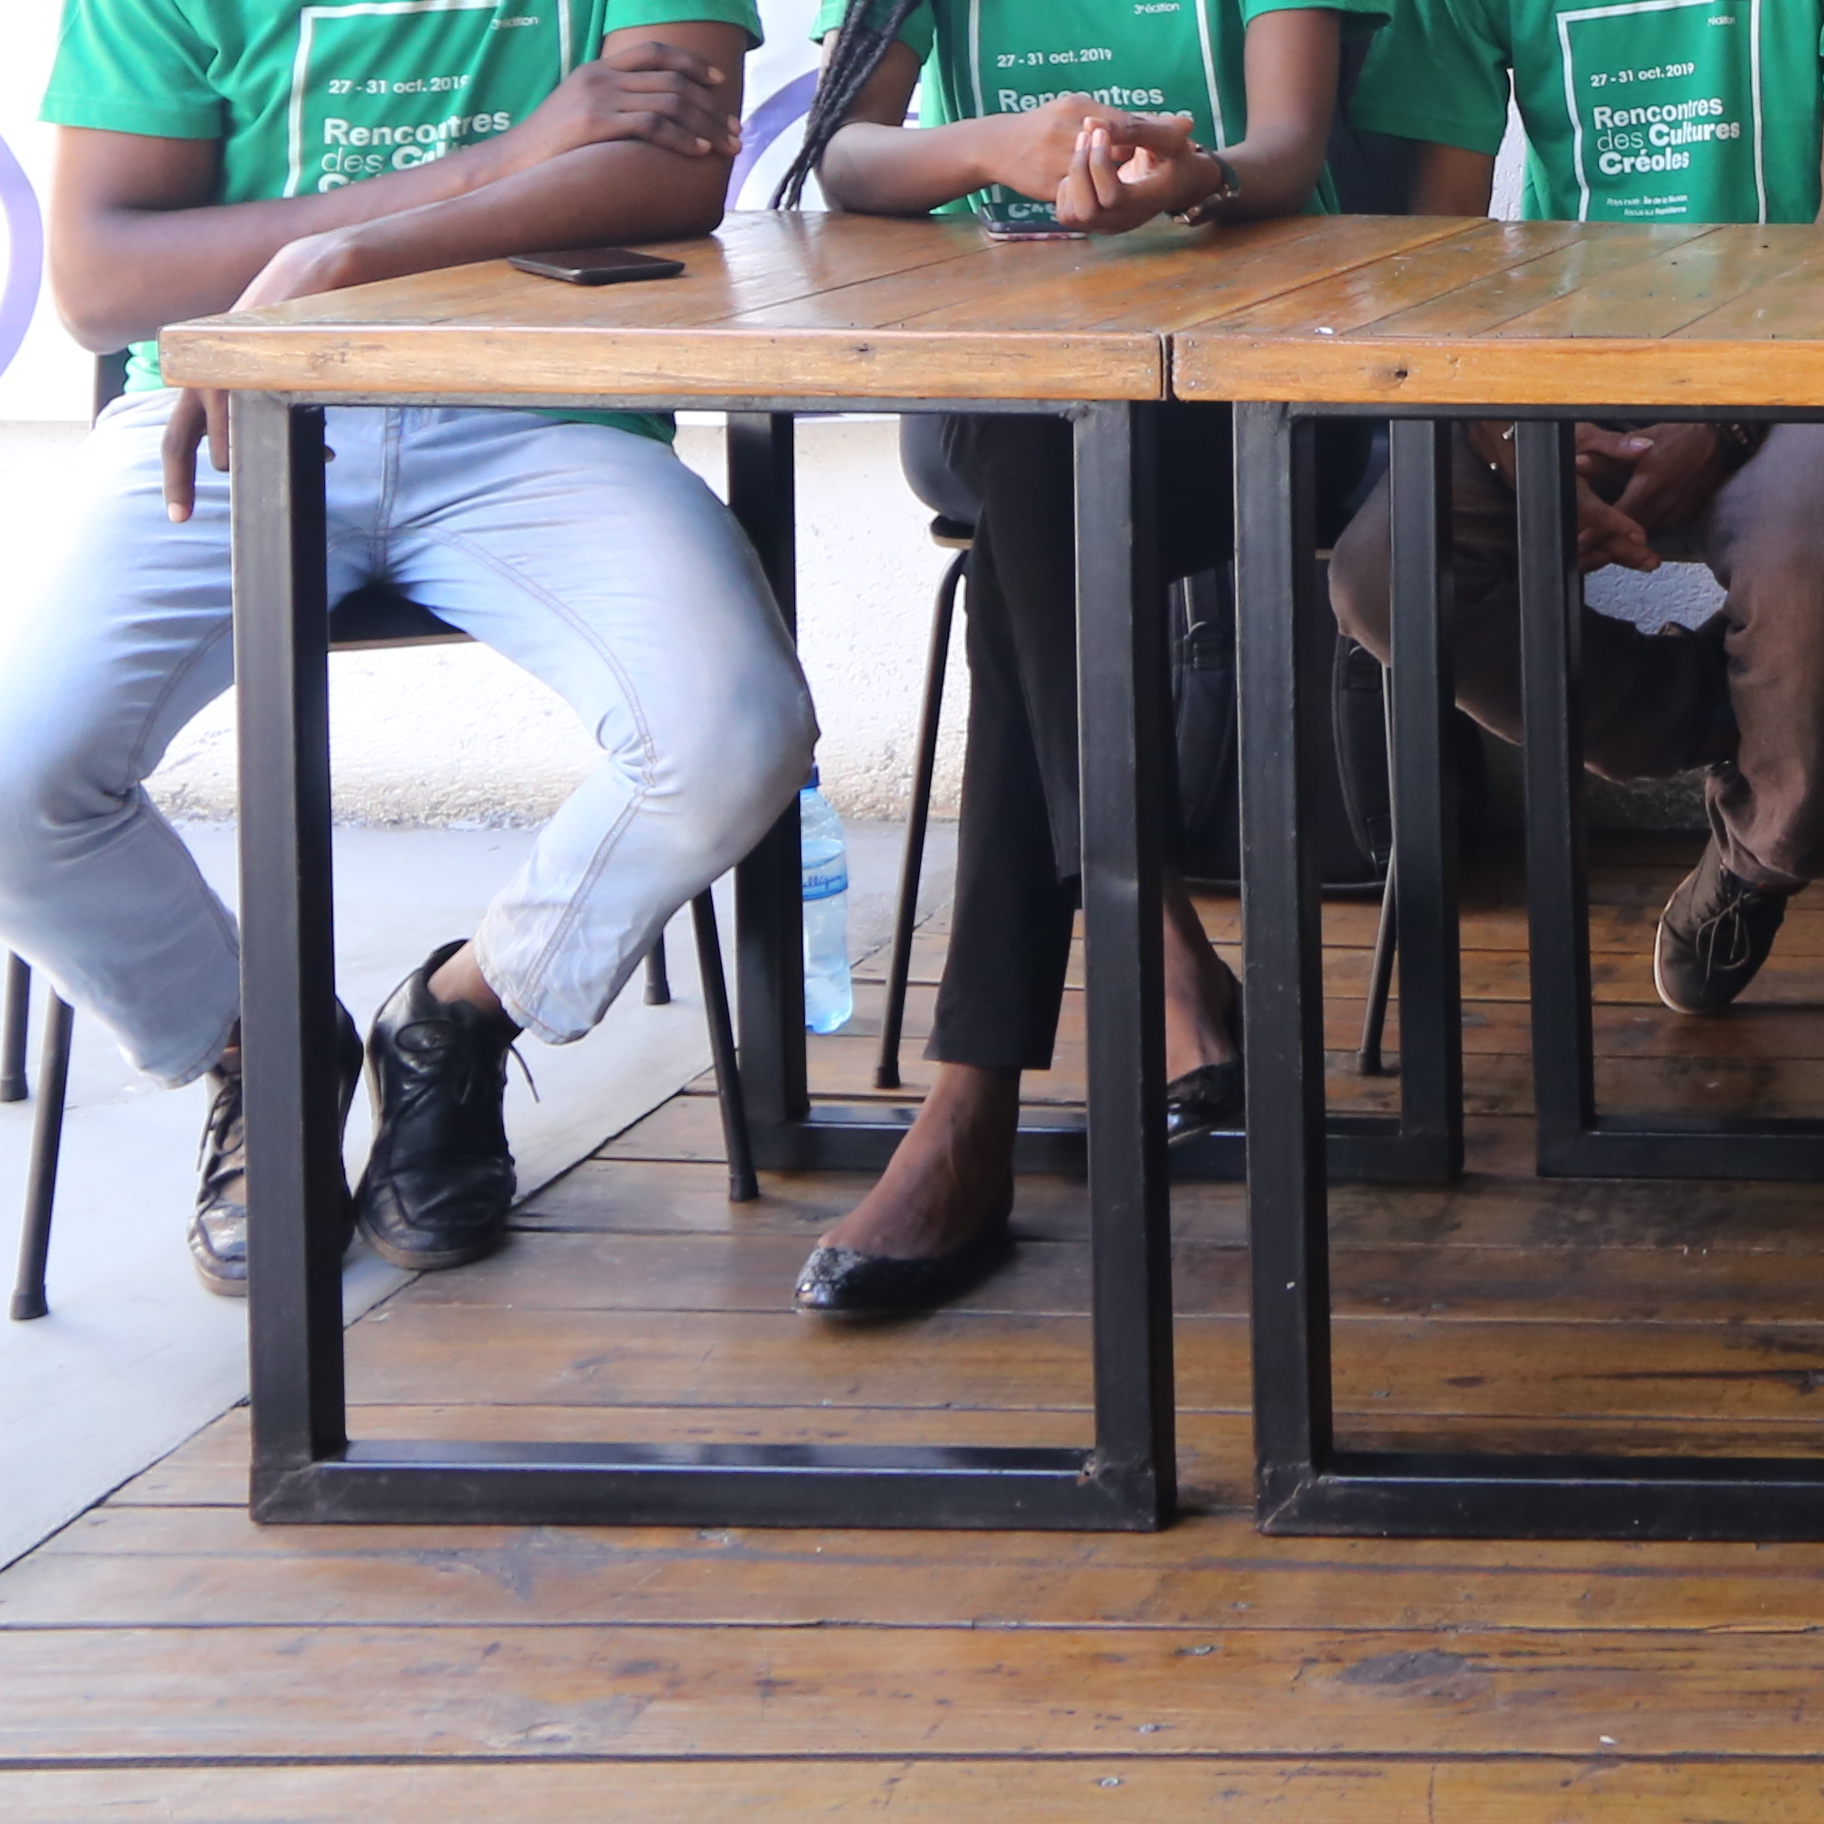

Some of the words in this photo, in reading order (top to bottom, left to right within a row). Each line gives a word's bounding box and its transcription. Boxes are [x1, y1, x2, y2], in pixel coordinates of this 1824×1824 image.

[996, 53, 1015, 68] 27
[1027, 52, 1044, 66] 31
[1049, 50, 1078, 65] oct.
[1080, 47, 1112, 62] 2019
[328, 79, 353, 95] 27
[365, 79, 387, 95] 31
[393, 77, 427, 94] oct.
[1590, 73, 1608, 88] 27
[1618, 69, 1634, 83] 31
[1638, 66, 1665, 82] oct.
[1665, 62, 1695, 77] 2019
[998, 85, 1165, 113] Renntres
[1592, 97, 1724, 131] Rencontres
[1597, 129, 1645, 153] des
[1648, 121, 1741, 148] Cultures
[320, 147, 384, 174] des
[1599, 147, 1690, 175] Créoles
